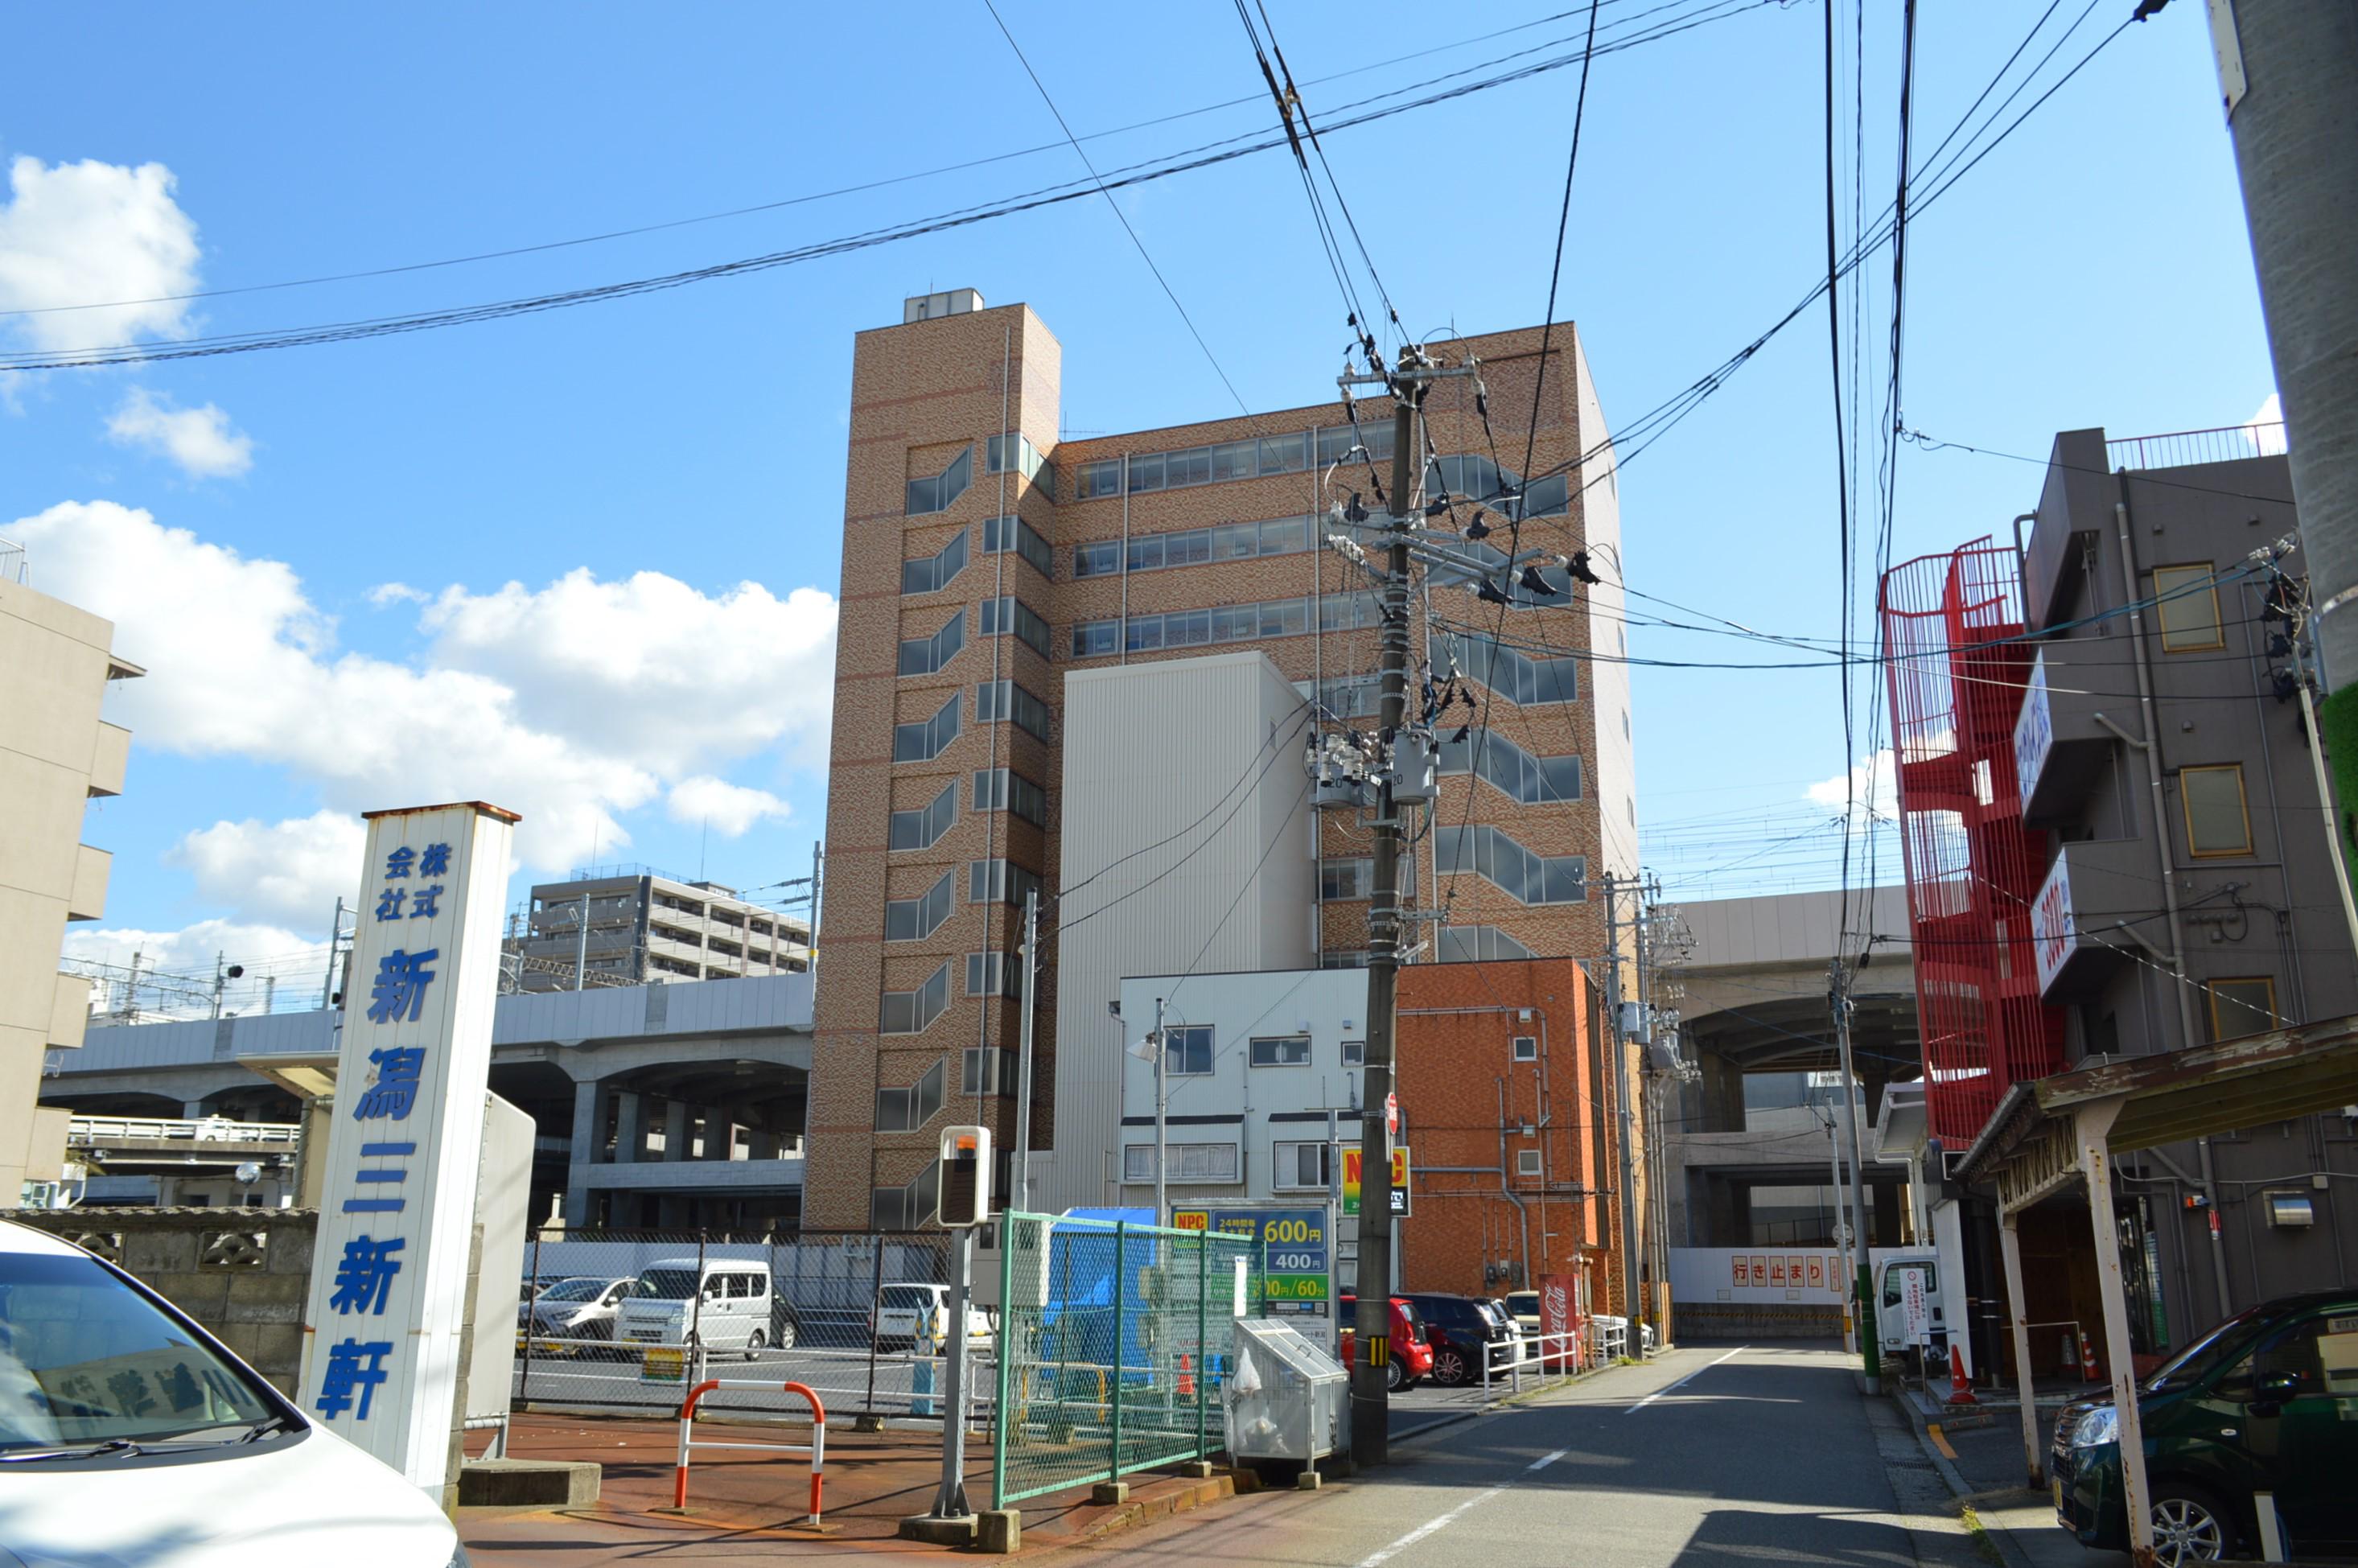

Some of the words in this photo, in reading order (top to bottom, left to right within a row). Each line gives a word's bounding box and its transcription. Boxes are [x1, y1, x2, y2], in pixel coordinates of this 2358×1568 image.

[1346, 1153, 1403, 1183] NC
[315, 948, 439, 1421] 新潟三新軒
[1178, 1215, 1204, 1230] NPC
[1734, 1264, 1821, 1279] 行き止まり
[1545, 1282, 1567, 1349] Cca-Cola
